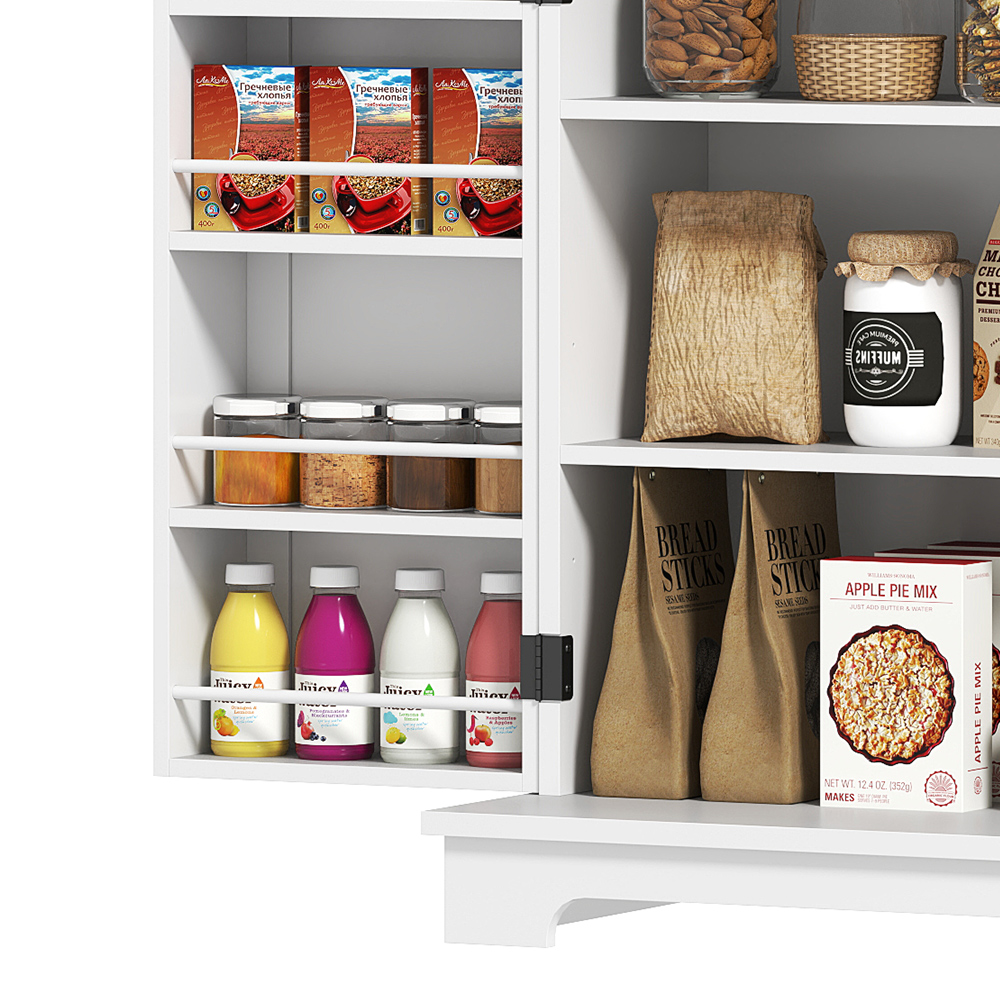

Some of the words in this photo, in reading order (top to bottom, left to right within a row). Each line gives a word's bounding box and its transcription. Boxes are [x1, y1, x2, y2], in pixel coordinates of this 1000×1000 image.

[239, 82, 292, 92] Гречневые
[355, 84, 408, 94] Гречневые
[257, 92, 291, 100] хлопья
[655, 519, 718, 558] BREAD
[764, 522, 827, 562] BREAD
[661, 552, 726, 593] STICKS
[845, 582, 886, 597] APPLE
[890, 584, 909, 598] PIE
[914, 585, 938, 599] MIX
[974, 661, 982, 687] MIX
[824, 778, 839, 788] NET
[841, 779, 856, 788] WT.
[858, 780, 873, 789] 12.4
[876, 781, 887, 790] OZ.
[889, 781, 912, 792] (352g)
[824, 792, 855, 802] MAKES
